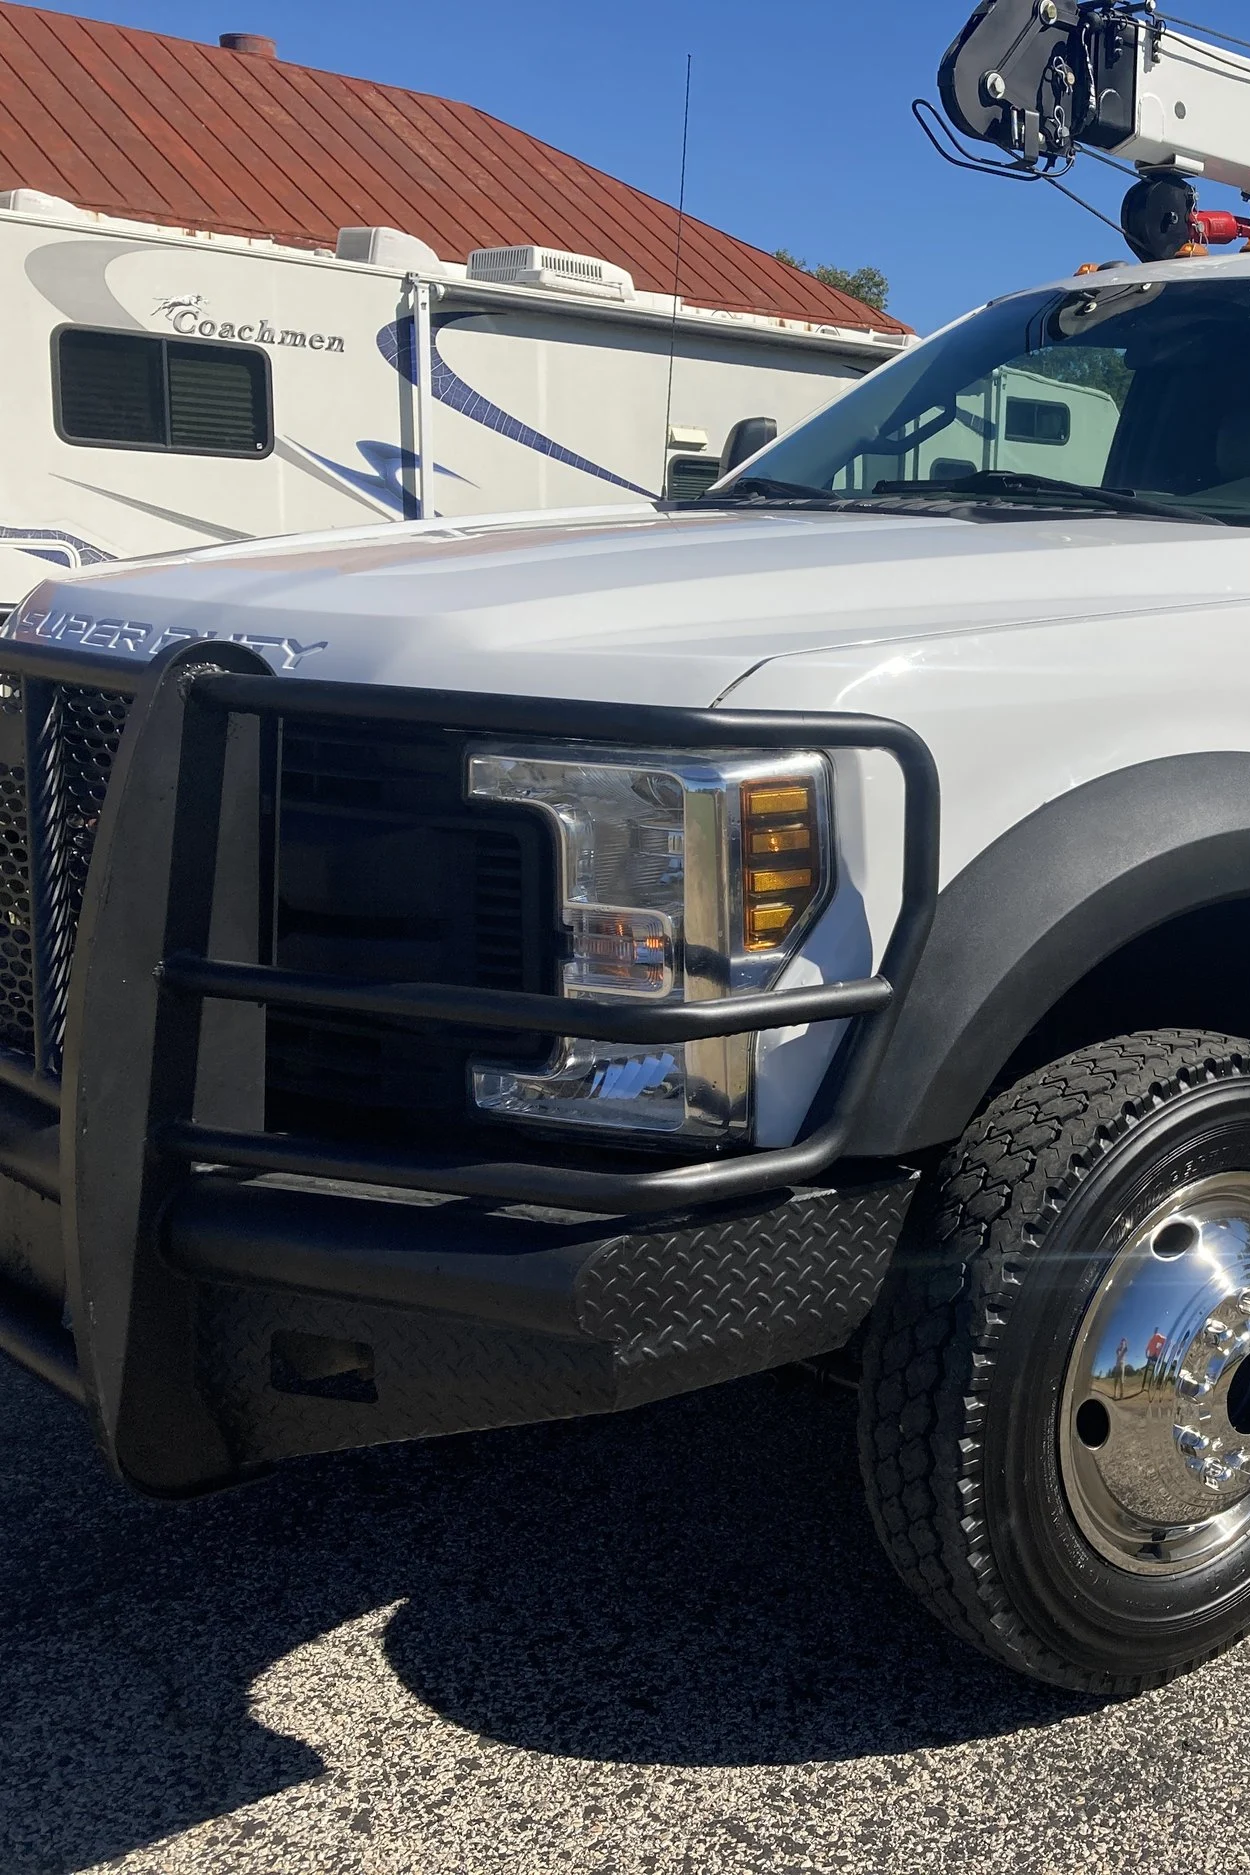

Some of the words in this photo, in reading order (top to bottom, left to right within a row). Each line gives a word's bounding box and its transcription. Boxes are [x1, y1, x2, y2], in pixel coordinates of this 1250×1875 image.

[173, 309, 345, 352] Coachmen
[21, 610, 153, 652] SUPER
[149, 626, 328, 669] DTY
